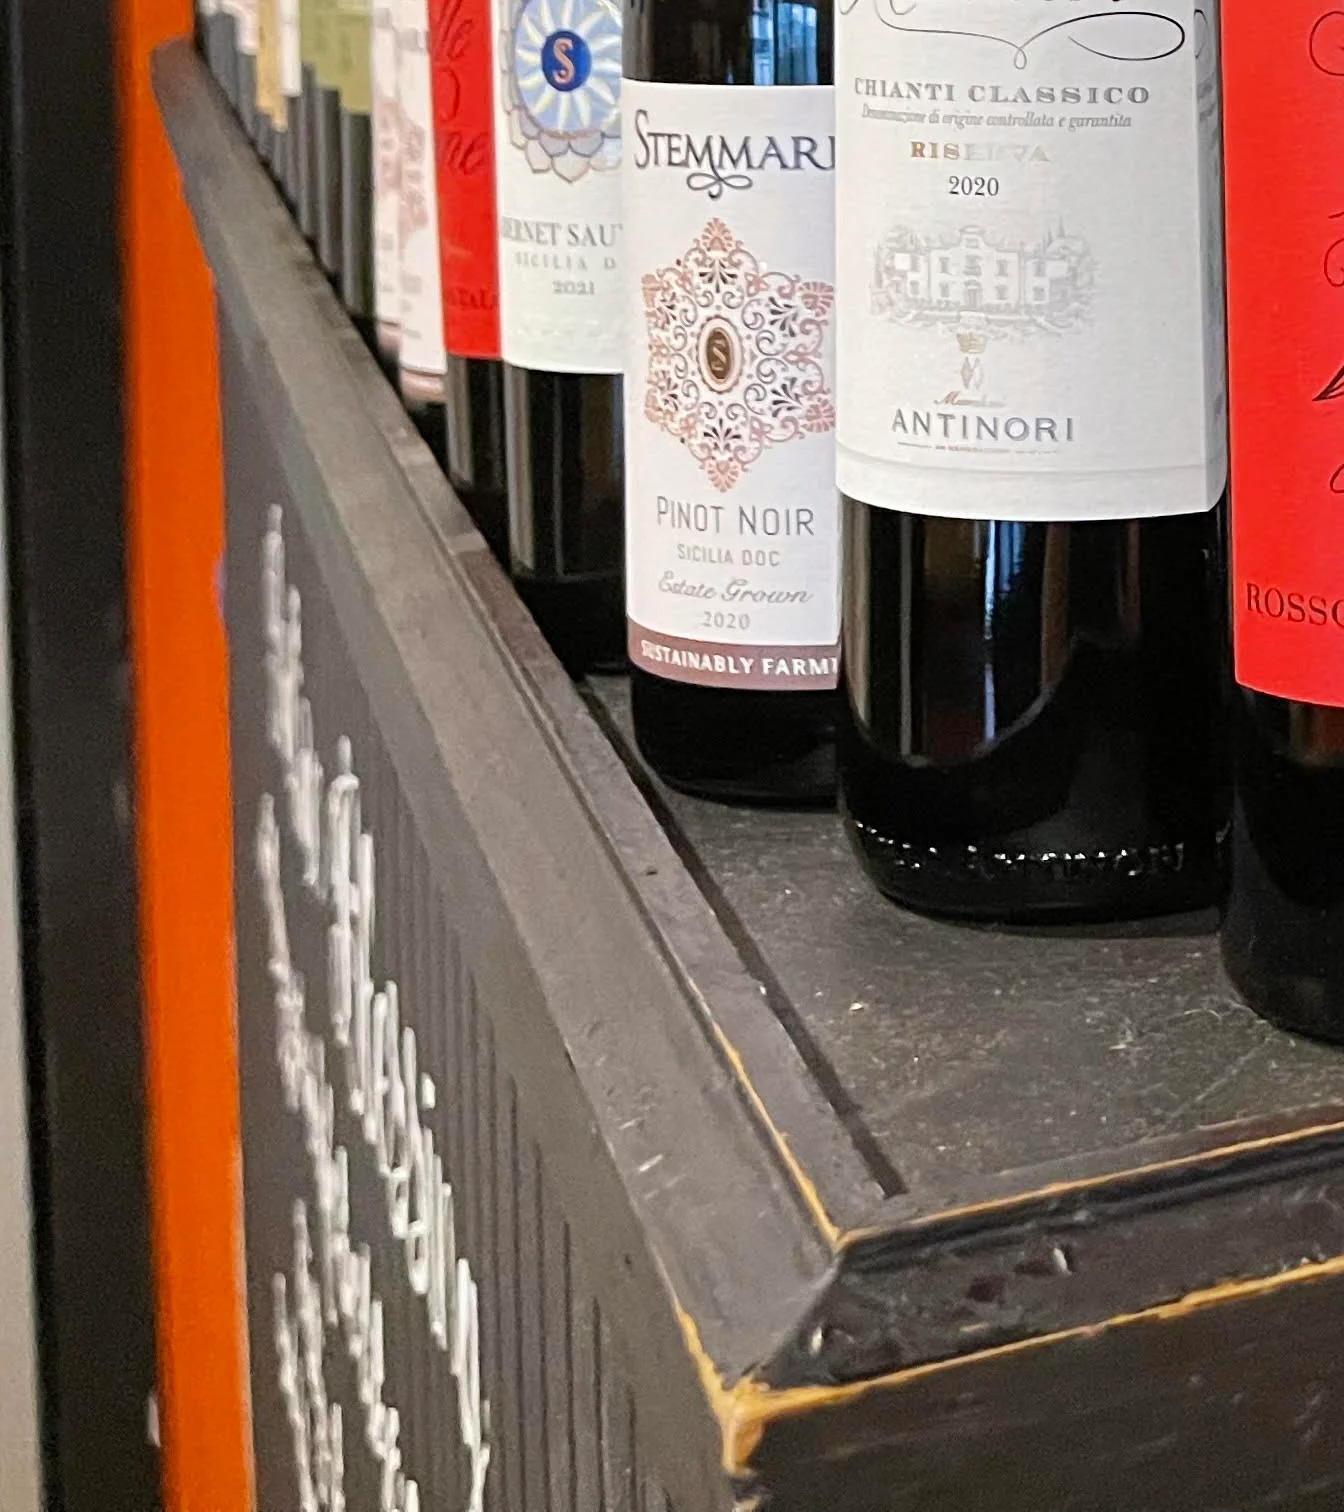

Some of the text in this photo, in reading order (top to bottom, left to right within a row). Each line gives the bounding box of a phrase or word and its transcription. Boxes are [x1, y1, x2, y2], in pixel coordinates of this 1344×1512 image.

[854, 77, 1151, 105] CHIANTI CLASSICO
[947, 175, 1000, 197] 2020
[891, 408, 1076, 442] ANTINORI
[656, 496, 815, 536] PINOT NOIR
[677, 543, 782, 567] SICILIA DOC
[658, 570, 815, 604] Estate Grown
[702, 610, 751, 630] 2020
[640, 639, 754, 675] SUSTAINABLY
